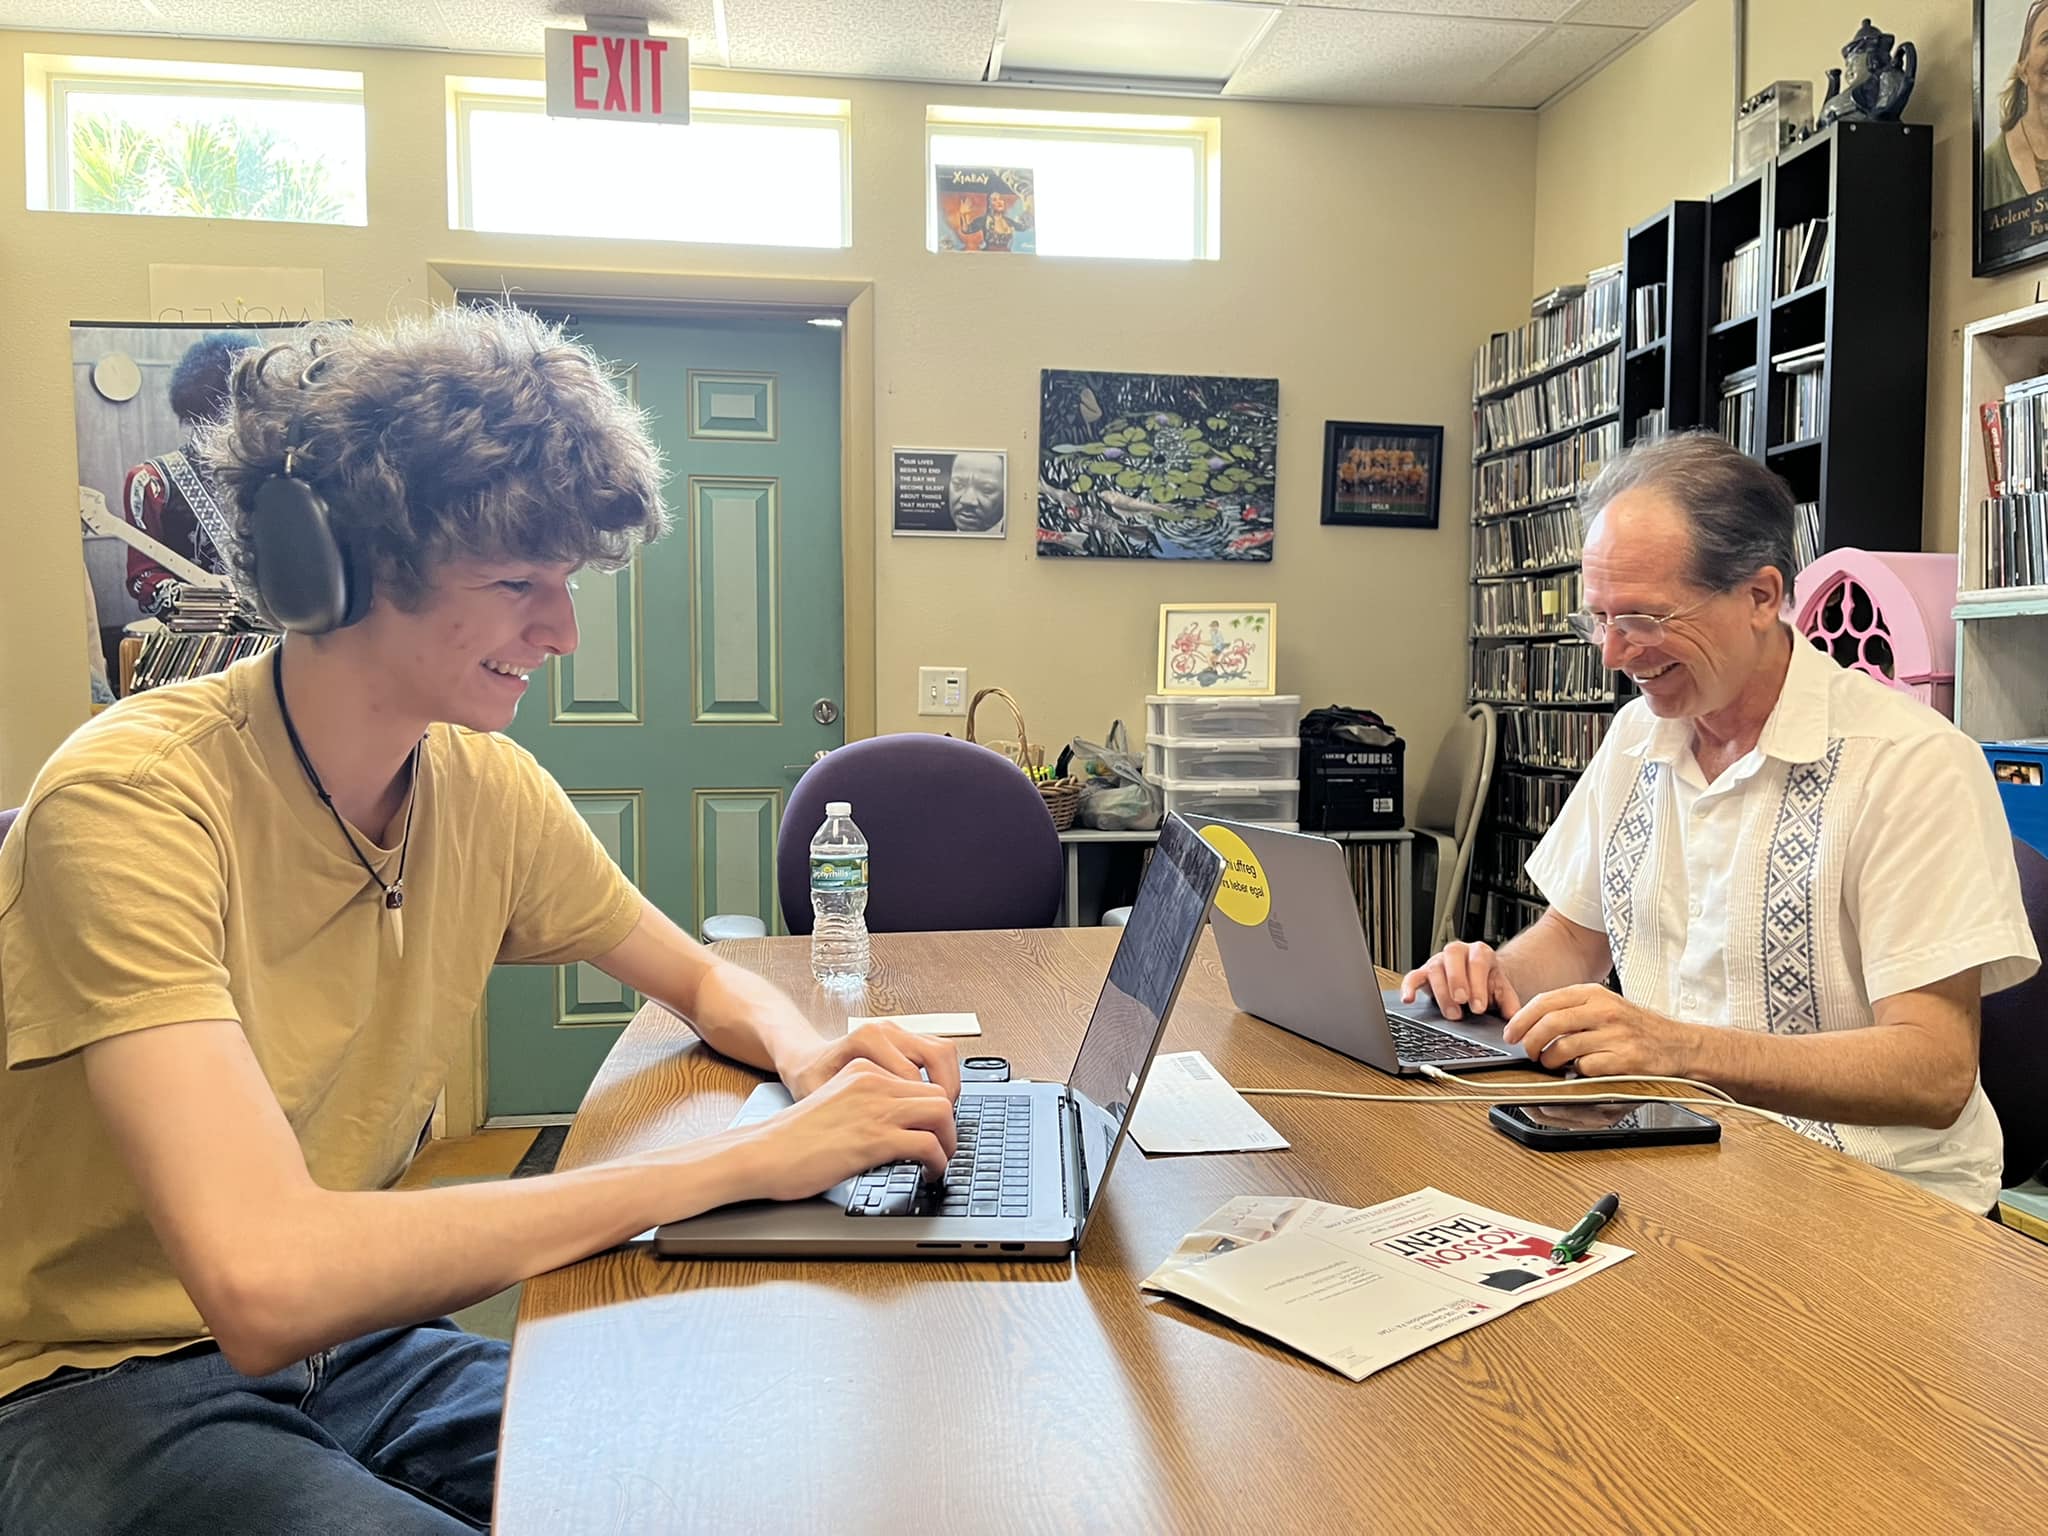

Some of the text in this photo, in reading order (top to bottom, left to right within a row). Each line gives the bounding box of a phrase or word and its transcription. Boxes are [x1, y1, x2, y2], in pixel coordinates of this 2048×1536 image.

[573, 34, 668, 114] EXIT
[1990, 208, 2031, 230] Arlene
[1346, 752, 1393, 764] CUBE
[1249, 886, 1264, 898] egal
[1384, 1217, 1492, 1256] TALENT
[1414, 1228, 1523, 1269] KOSSON
